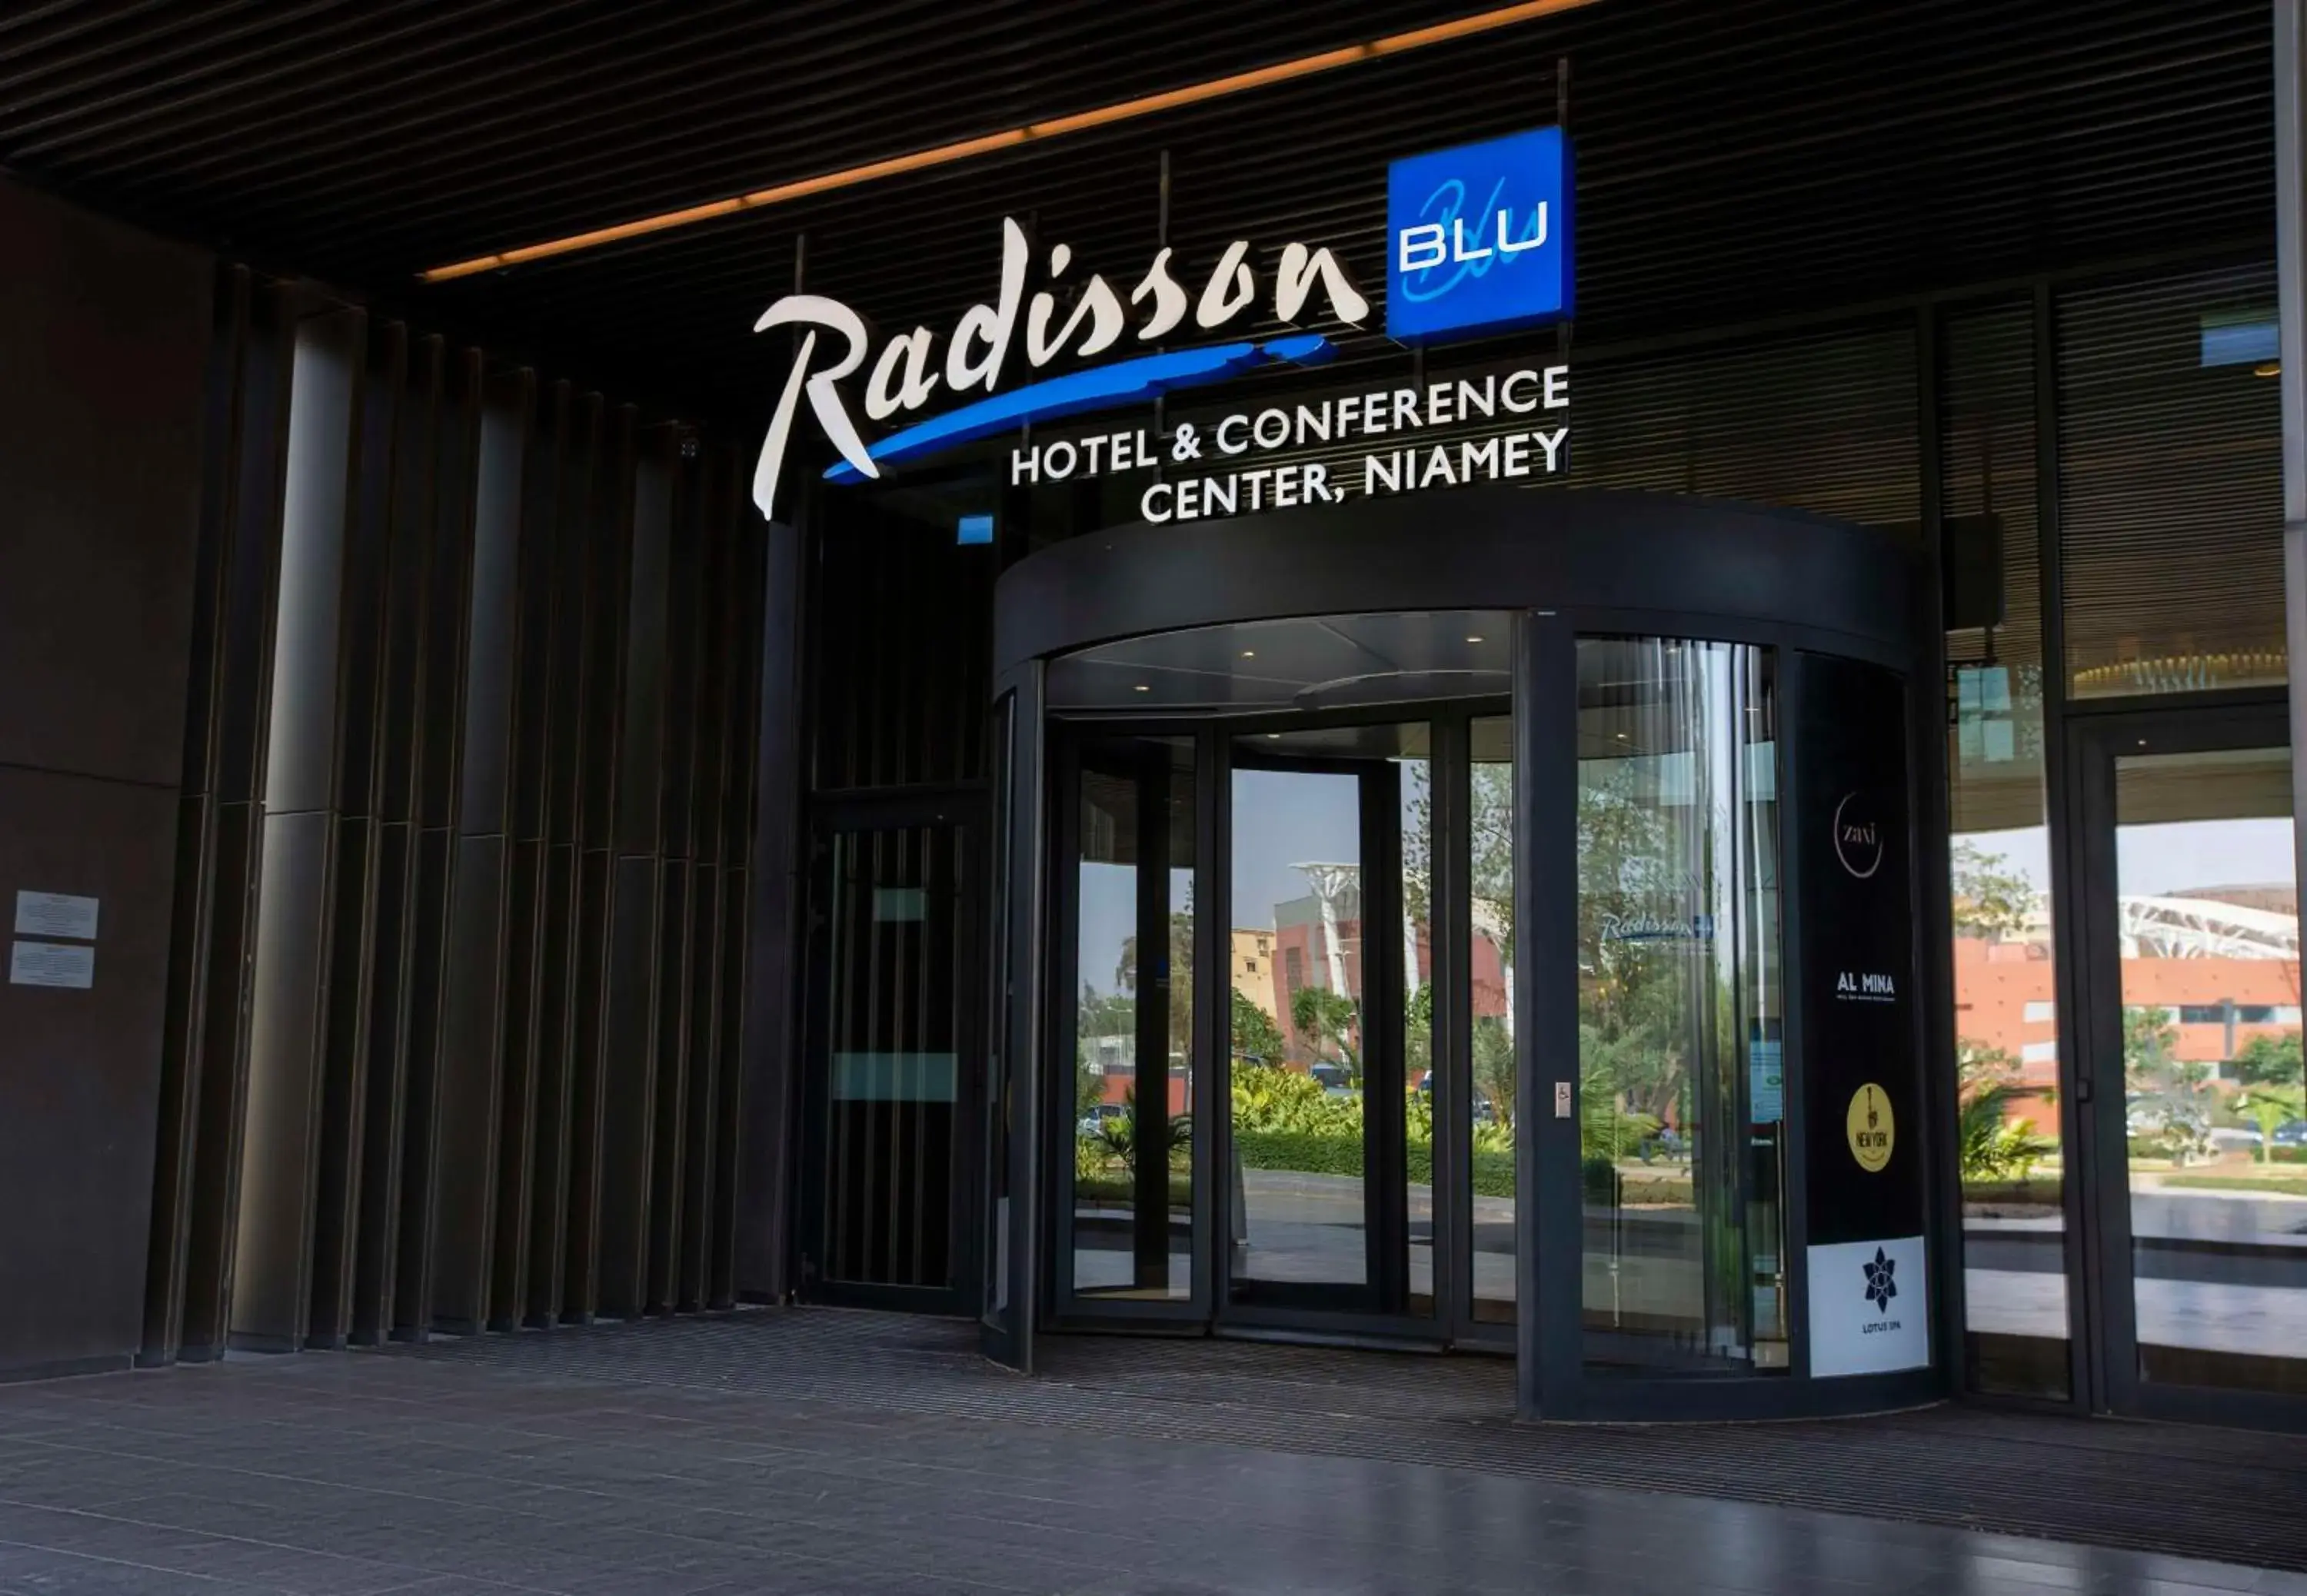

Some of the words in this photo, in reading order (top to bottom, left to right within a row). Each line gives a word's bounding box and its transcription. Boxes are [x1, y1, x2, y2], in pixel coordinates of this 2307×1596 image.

[753, 217, 1369, 521] Radisson
[1400, 201, 1547, 273] BLU
[1011, 429, 1157, 486] HOTEL
[1171, 422, 1200, 461] &
[1217, 365, 1570, 454] CONFERENCE
[1141, 463, 1345, 523] CENTER,
[1366, 428, 1570, 494] NIAMEY
[1837, 971, 1858, 991] AL
[1862, 973, 1895, 993] MINA
[1863, 1322, 1887, 1334] LOTUS
